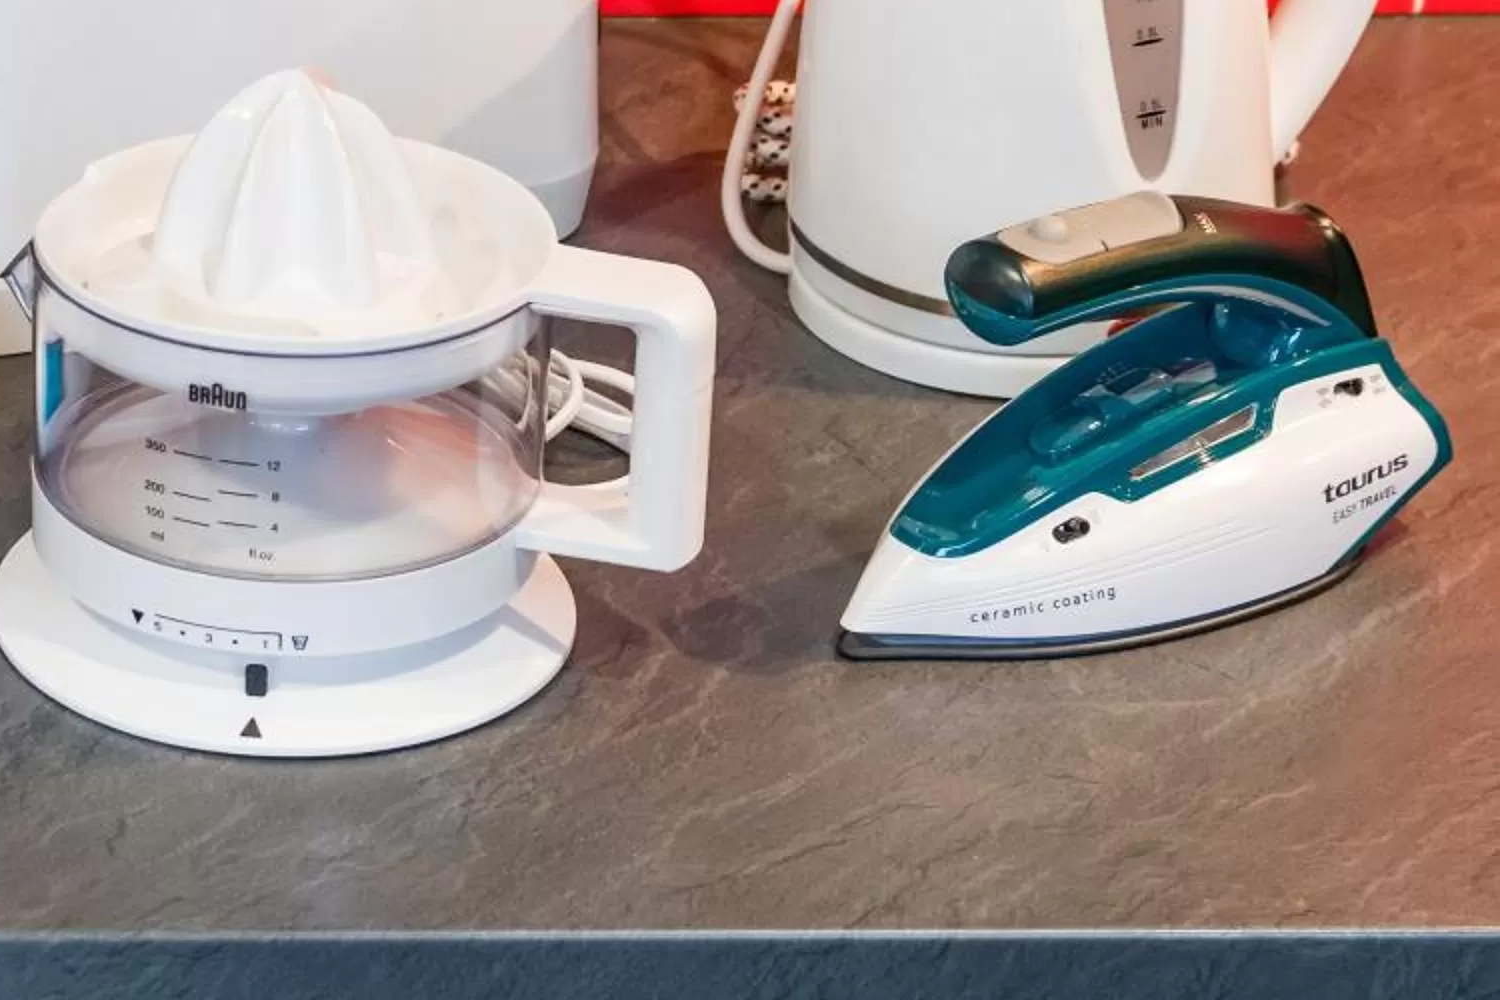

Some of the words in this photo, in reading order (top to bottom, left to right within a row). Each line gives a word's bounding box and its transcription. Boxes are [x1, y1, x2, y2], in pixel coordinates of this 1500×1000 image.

[188, 382, 247, 409] BRAUN
[1322, 453, 1409, 504] taurus
[1359, 485, 1397, 510] TRAVEL
[970, 601, 1045, 623] ceramic
[1053, 586, 1117, 610] coating
